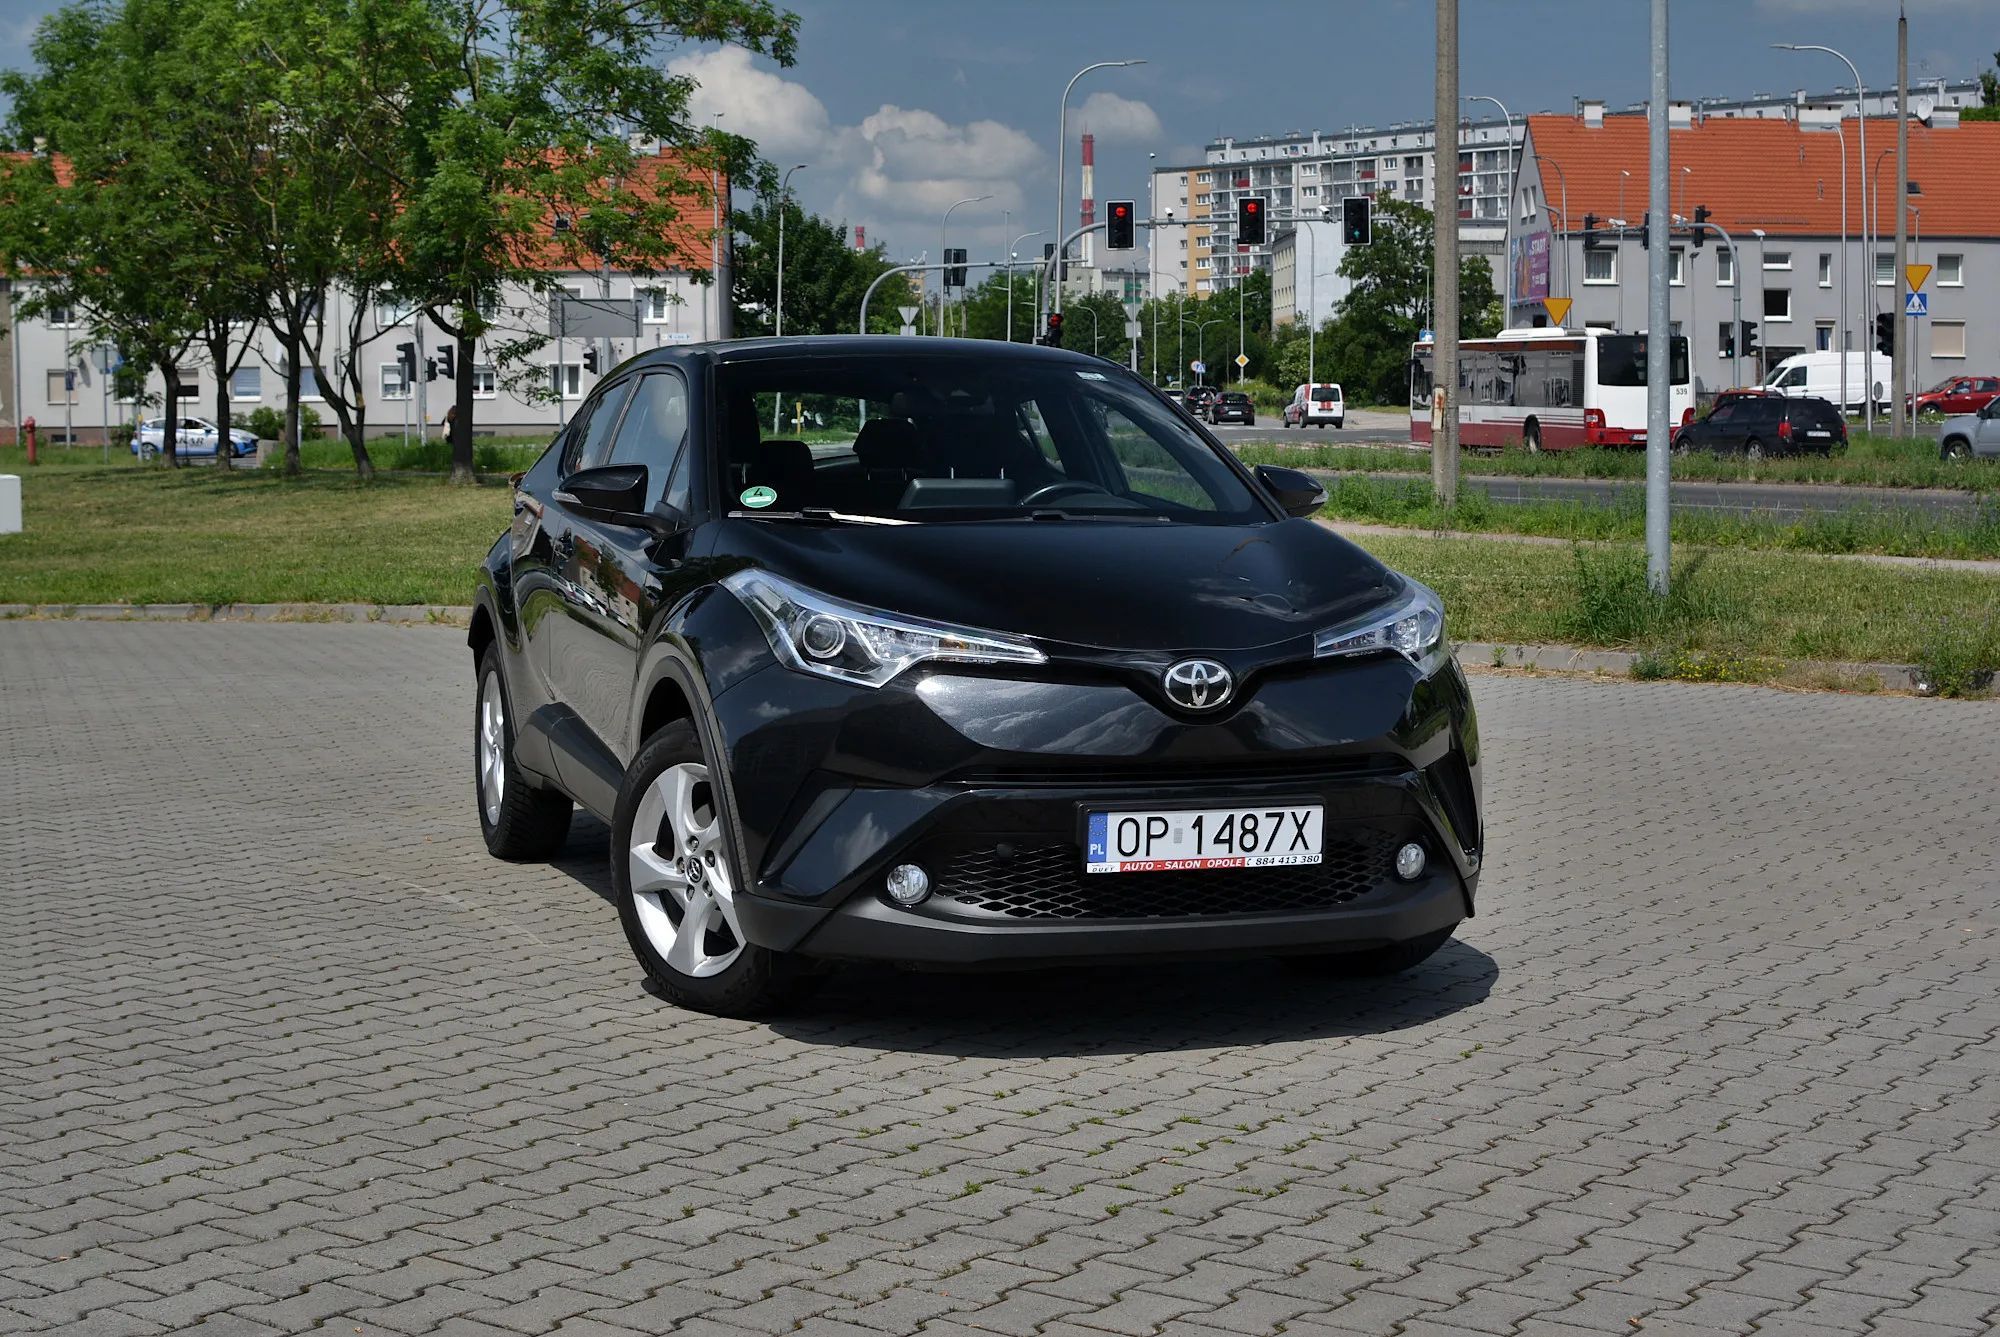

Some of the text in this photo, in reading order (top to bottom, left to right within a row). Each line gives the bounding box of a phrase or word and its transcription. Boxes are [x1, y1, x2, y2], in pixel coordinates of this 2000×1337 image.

[1675, 387, 1688, 395] 539
[753, 487, 763, 496] 4
[1117, 810, 1311, 857] OP 1487X
[1090, 843, 1104, 855] PL
[1123, 862, 1154, 871] AUTO
[1164, 860, 1201, 870] SALON
[1206, 859, 1242, 868] OPOLE
[1255, 857, 1275, 866] 884
[1278, 856, 1298, 864] 413
[1300, 855, 1319, 863] 380
